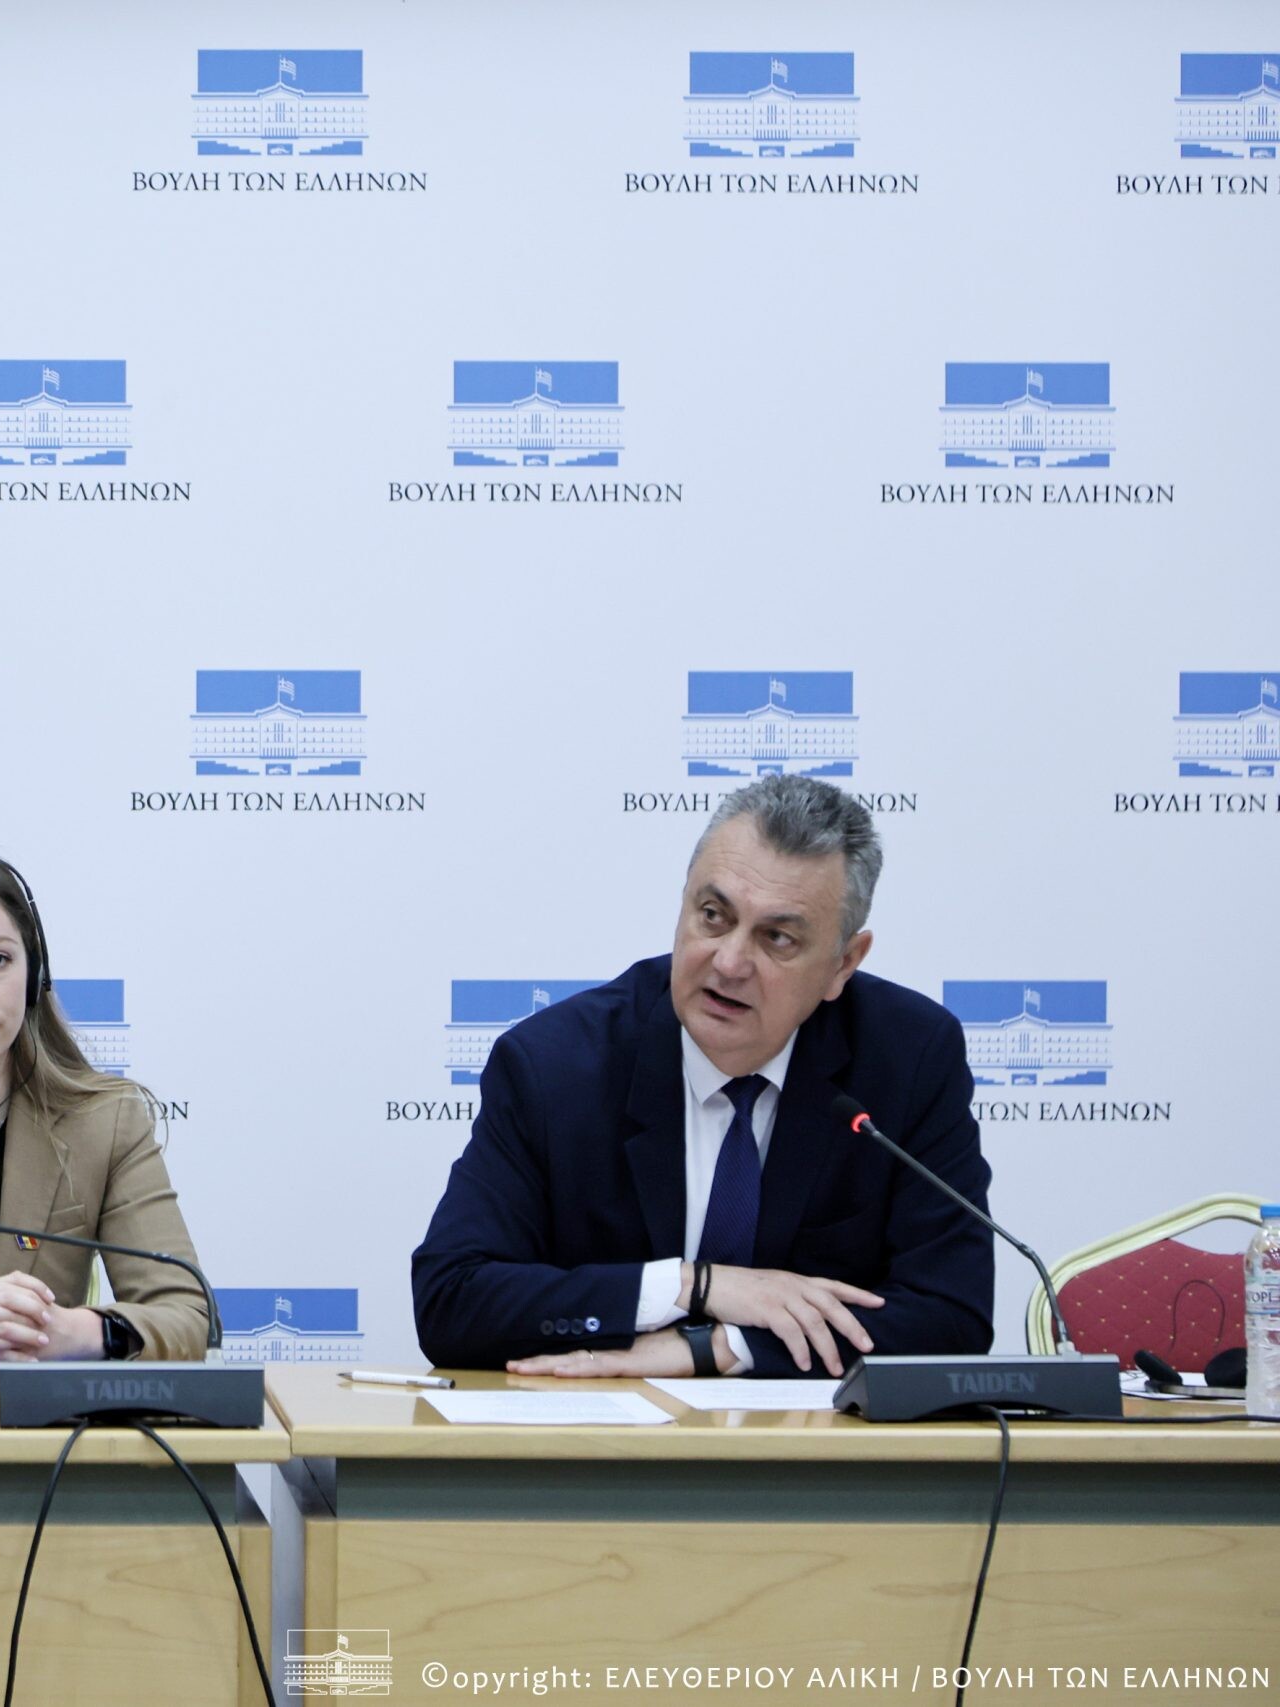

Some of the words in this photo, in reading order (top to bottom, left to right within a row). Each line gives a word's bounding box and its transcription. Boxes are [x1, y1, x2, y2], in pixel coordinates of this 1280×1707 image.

[133, 172, 219, 191] ΒΟΥΛΗ
[229, 172, 284, 191] ΤΩΝ
[296, 173, 426, 192] ΕΛΛΗΝΩΝ
[626, 173, 711, 192] ΒΟΥΛΗ
[720, 174, 776, 193] ΤΩΝ
[788, 174, 918, 193] ΕΛΛΗΝΩΝ
[1117, 175, 1202, 194] ΒΟΥΛΗ
[1211, 175, 1267, 194] ΤΩΝ
[59, 482, 190, 501] ΕΛΛΗΝΩΝ
[389, 483, 475, 502] ΒΟΥΛΗ
[484, 483, 540, 502] ΤΩΝ
[552, 484, 682, 502] ΕΛΛΗΝΩΝ
[882, 484, 966, 503] ΒΟΥΛΗ
[976, 485, 1031, 503] ΤΩΝ
[1043, 485, 1173, 503] ΕΛΛΗΝΩΝ
[131, 792, 218, 811] ΒΟΥΛΗ
[227, 792, 283, 811] ΤΩΝ
[294, 792, 425, 811] ΕΛΛΗΝΩΝ
[624, 793, 708, 812] ΒΟΥΛΗ
[1115, 794, 1200, 812] ΒΟΥΛΗ
[1210, 794, 1266, 812] ΤΩΝ
[387, 1102, 474, 1121] ΒΟΥΛΗ
[974, 1102, 1030, 1121] ΤΩΝ
[1040, 1102, 1171, 1121] ΕΛΛΗΝΩΝ
[82, 1379, 175, 1401] TAIDEN
[946, 1372, 1036, 1394] TAIDEN
